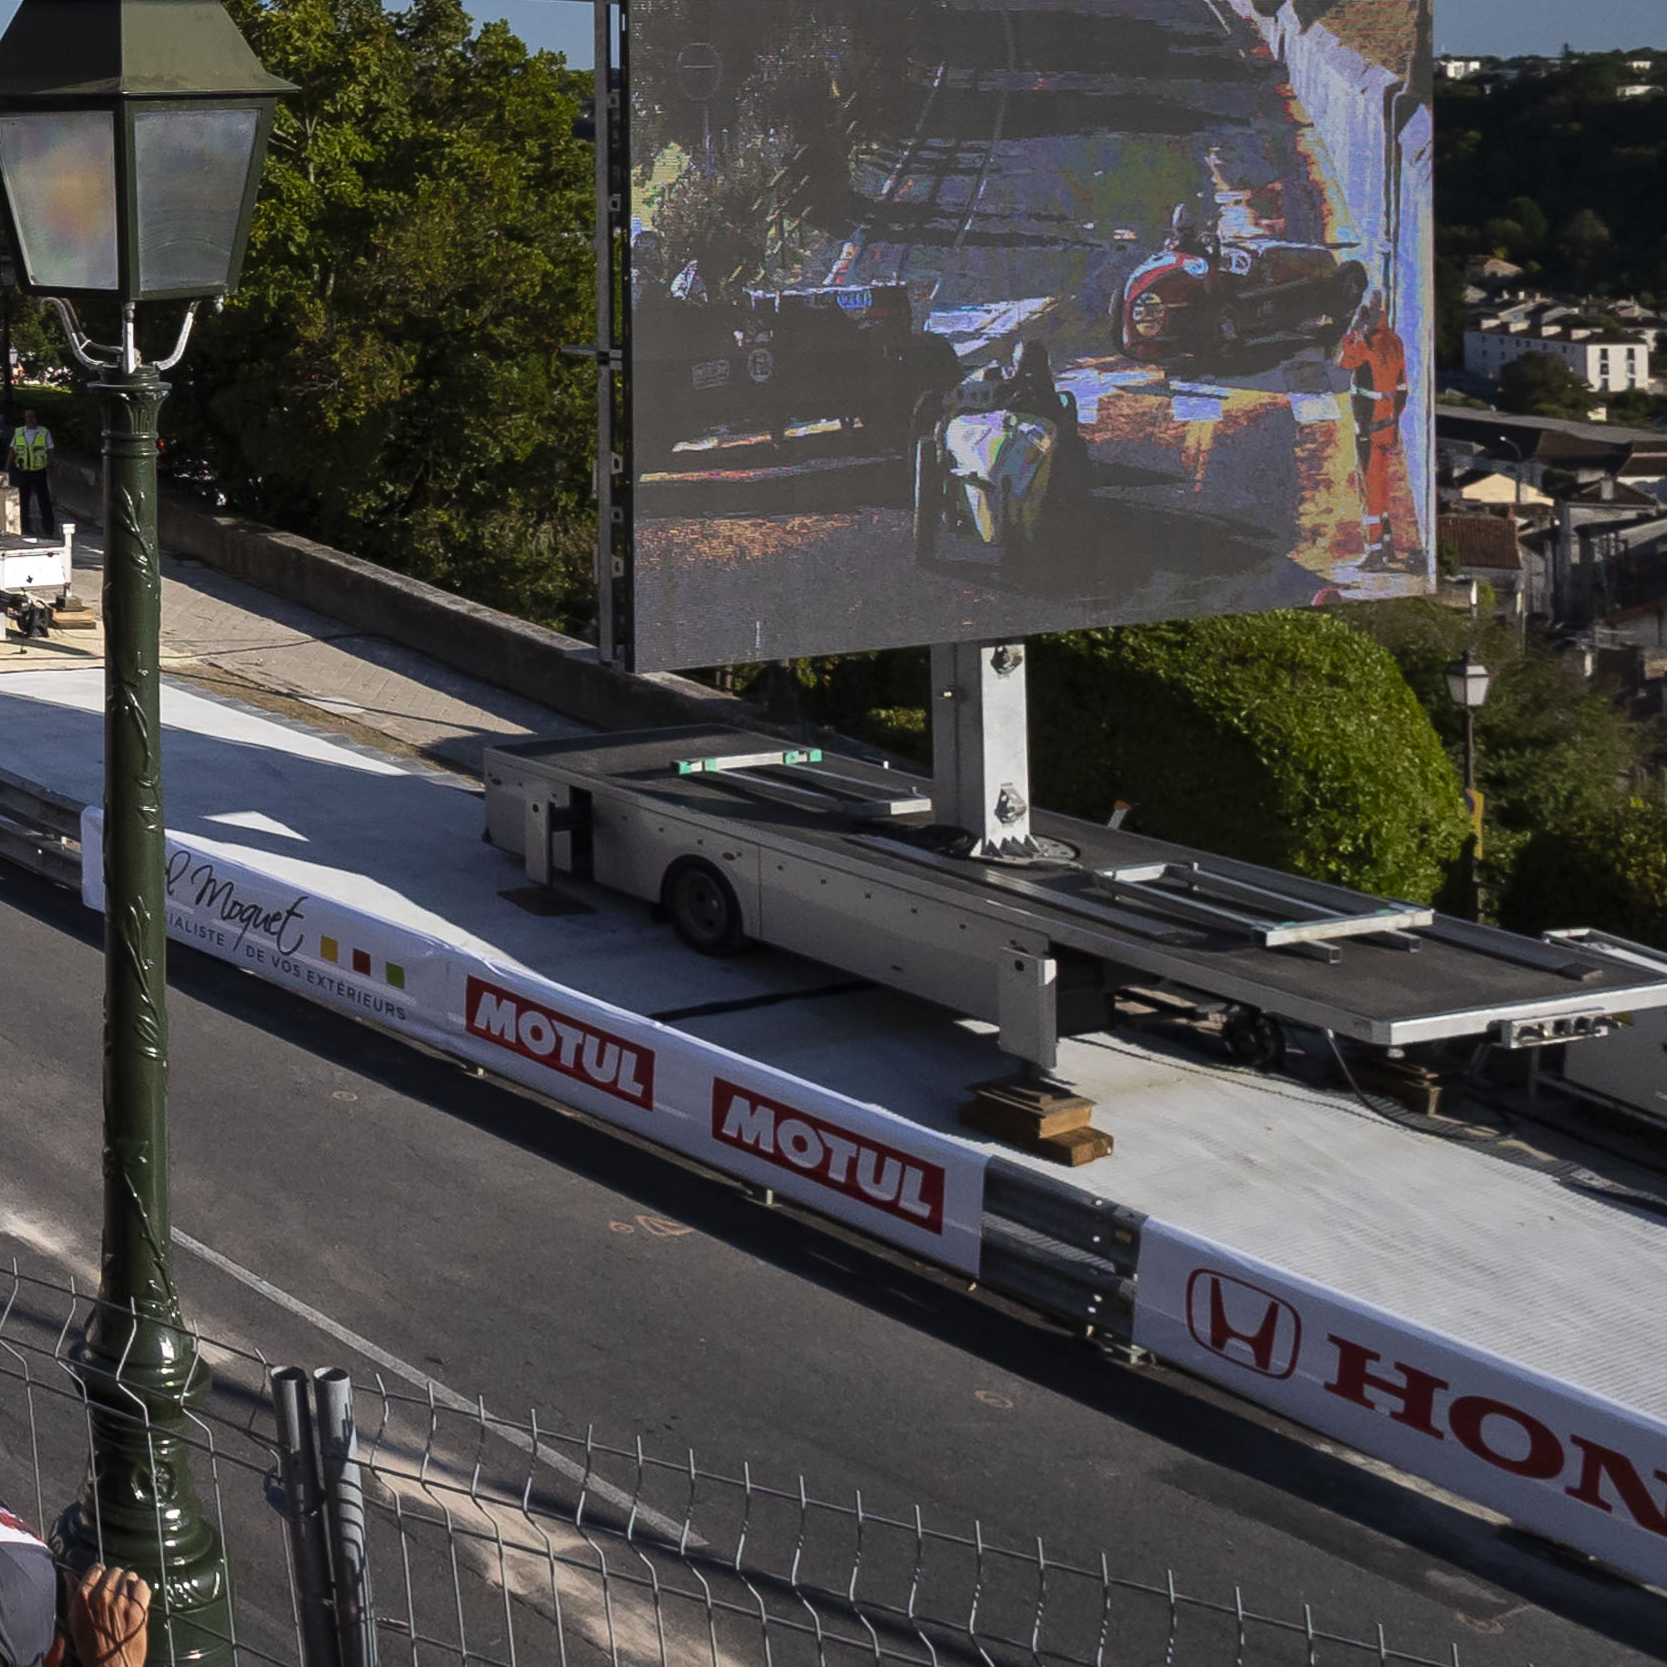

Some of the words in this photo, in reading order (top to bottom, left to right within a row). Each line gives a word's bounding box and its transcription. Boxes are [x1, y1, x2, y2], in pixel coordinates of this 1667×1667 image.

[190, 865, 309, 956] Moquet
[169, 918, 224, 946] IALISTE
[246, 945, 264, 963] DE
[271, 956, 301, 978] VOS
[306, 970, 407, 1021] EXTÉRIEURS
[473, 991, 644, 1097] MOTUL
[722, 1095, 932, 1219] MOTUL
[1323, 1333, 1667, 1536] HON
